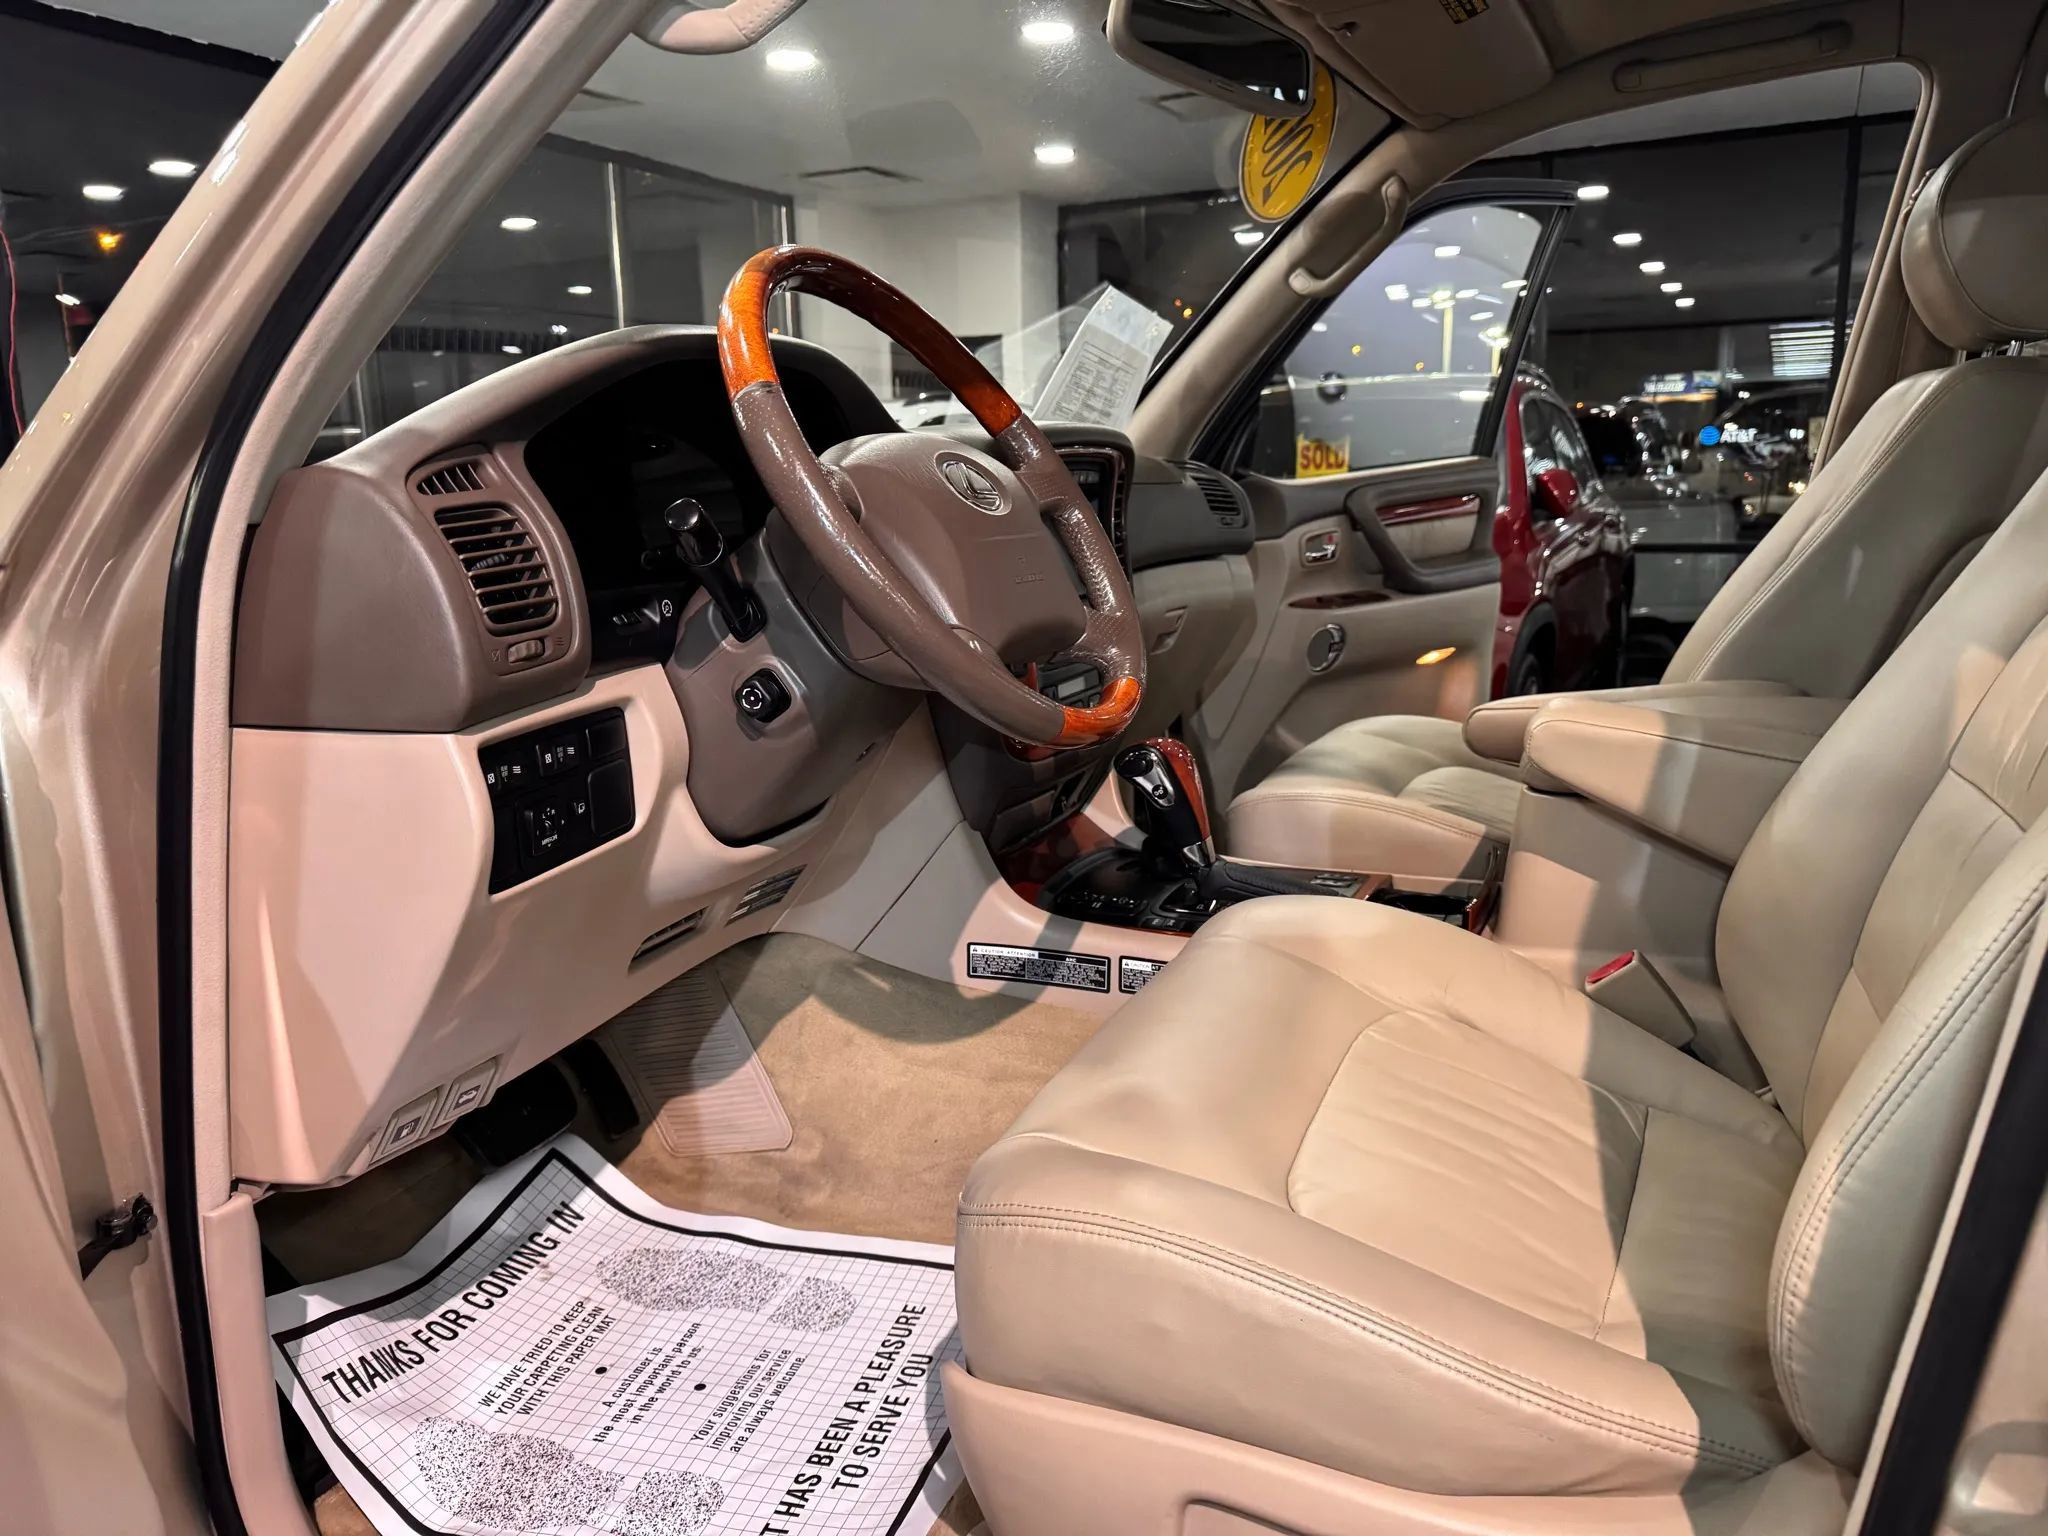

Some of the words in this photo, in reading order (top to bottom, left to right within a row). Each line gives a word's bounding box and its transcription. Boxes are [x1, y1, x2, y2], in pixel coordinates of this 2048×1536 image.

[1300, 443, 1346, 470] SOLD
[1720, 428, 1758, 444] AT&T
[322, 1339, 425, 1403] THANKS
[412, 1309, 477, 1353] FOR
[462, 1231, 561, 1310] COMING
[546, 1200, 585, 1235] IN
[478, 1390, 501, 1408] WE
[495, 1365, 527, 1391] HAVE
[520, 1337, 553, 1365] TRIED
[548, 1324, 566, 1336] TO
[561, 1301, 586, 1324] KEEP
[494, 1387, 529, 1415] YOUR
[523, 1335, 578, 1387] CARPETING
[573, 1306, 606, 1335] CLEAN
[517, 1389, 549, 1416] WITH
[542, 1366, 571, 1387] THIS
[565, 1335, 600, 1365] PAPER
[593, 1314, 617, 1334] MAT
[592, 1425, 614, 1443] the
[611, 1398, 637, 1423] most
[630, 1354, 676, 1396] important
[672, 1322, 702, 1354] person
[602, 1400, 616, 1408] A
[612, 1357, 653, 1399] customer
[647, 1347, 662, 1356] is
[627, 1414, 644, 1424] in
[638, 1396, 659, 1412] the
[655, 1370, 682, 1394] world
[676, 1360, 691, 1369] to
[687, 1346, 704, 1358] us.
[690, 1418, 717, 1441] Your
[712, 1364, 761, 1418] suggestions
[754, 1349, 772, 1362] for
[853, 1304, 927, 1395] PLEASURE
[706, 1400, 756, 1450] improving
[748, 1382, 766, 1398] our
[762, 1349, 792, 1382] service
[729, 1435, 749, 1453] are
[744, 1399, 775, 1434] always
[769, 1355, 809, 1397] welcome.
[806, 1416, 859, 1468] BEEN
[831, 1463, 869, 1489] TO
[852, 1395, 910, 1458] SERVE
[892, 1353, 934, 1388] YOU
[844, 1400, 870, 1413] A
[774, 1473, 822, 1517] HAS
